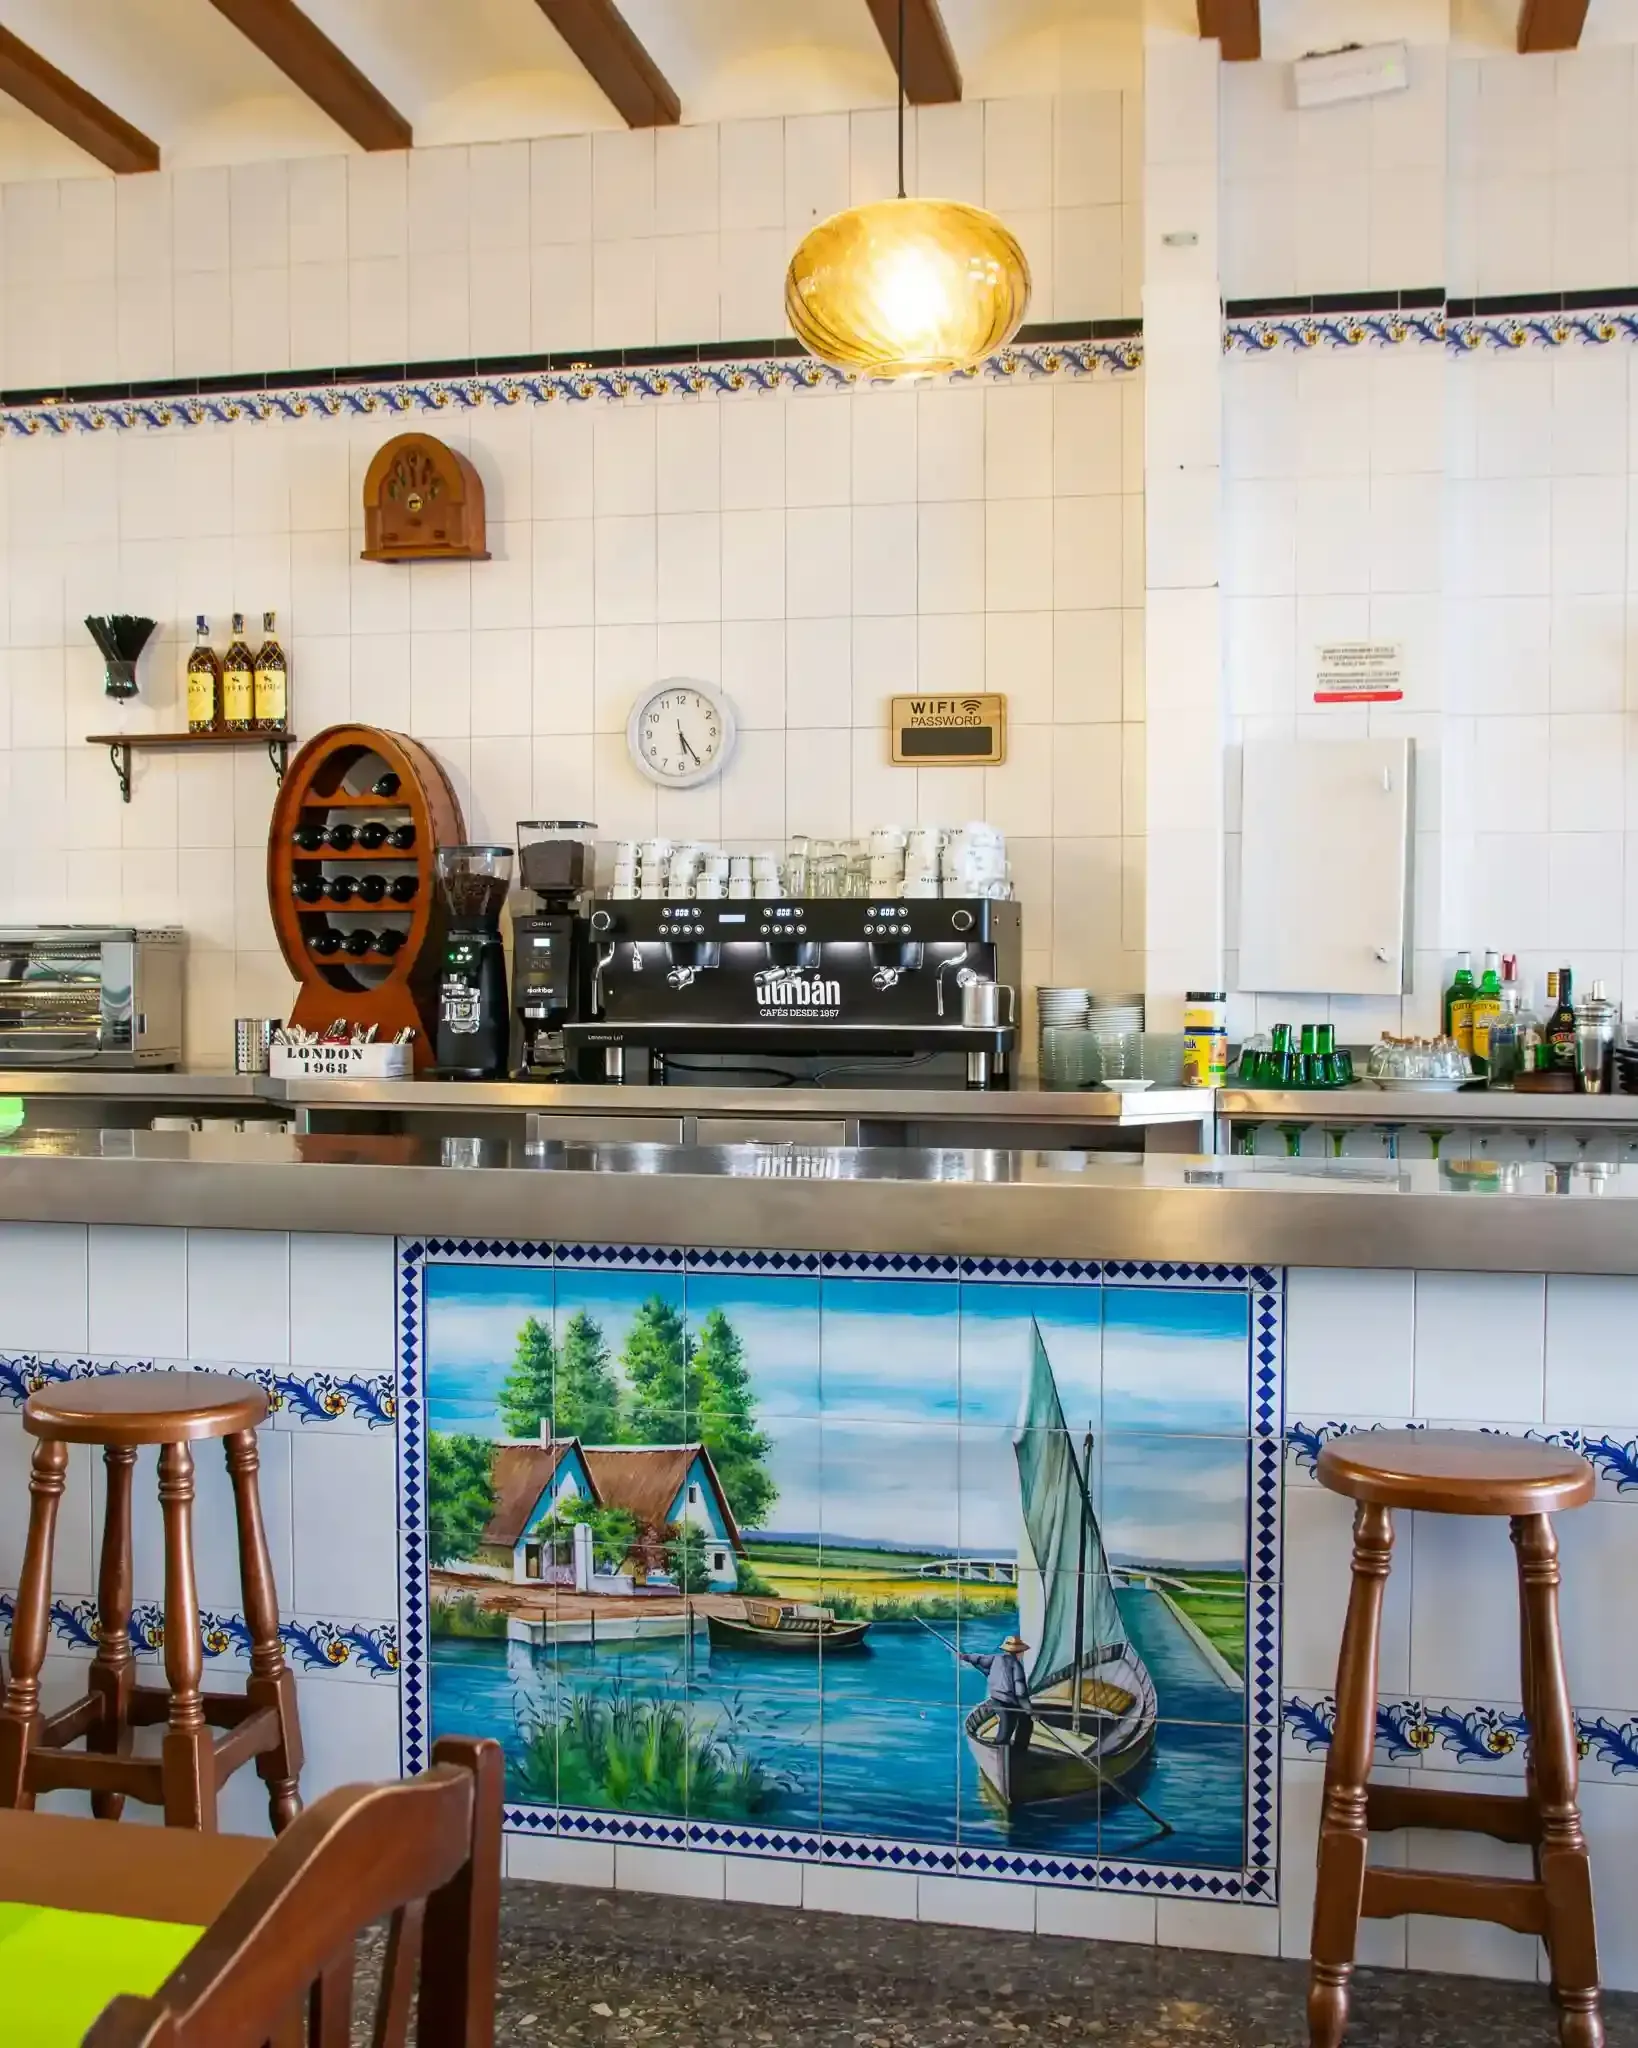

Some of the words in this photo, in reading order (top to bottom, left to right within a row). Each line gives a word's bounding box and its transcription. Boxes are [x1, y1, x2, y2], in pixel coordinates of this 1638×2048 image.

[661, 700, 670, 709] 11
[676, 695, 686, 705] 12
[910, 701, 955, 714] WIFI
[648, 713, 660, 723] 10
[705, 710, 712, 720] 2
[910, 715, 982, 727] PASSWORD
[646, 730, 653, 739] 9
[709, 727, 717, 736] 3
[705, 744, 712, 753] 4
[662, 758, 669, 767] 7
[678, 761, 685, 771] 6
[760, 1008, 788, 1017] CAFÉS
[790, 1009, 819, 1017] DESDE
[287, 1047, 364, 1060] LONDON
[304, 1062, 348, 1074] 1968
